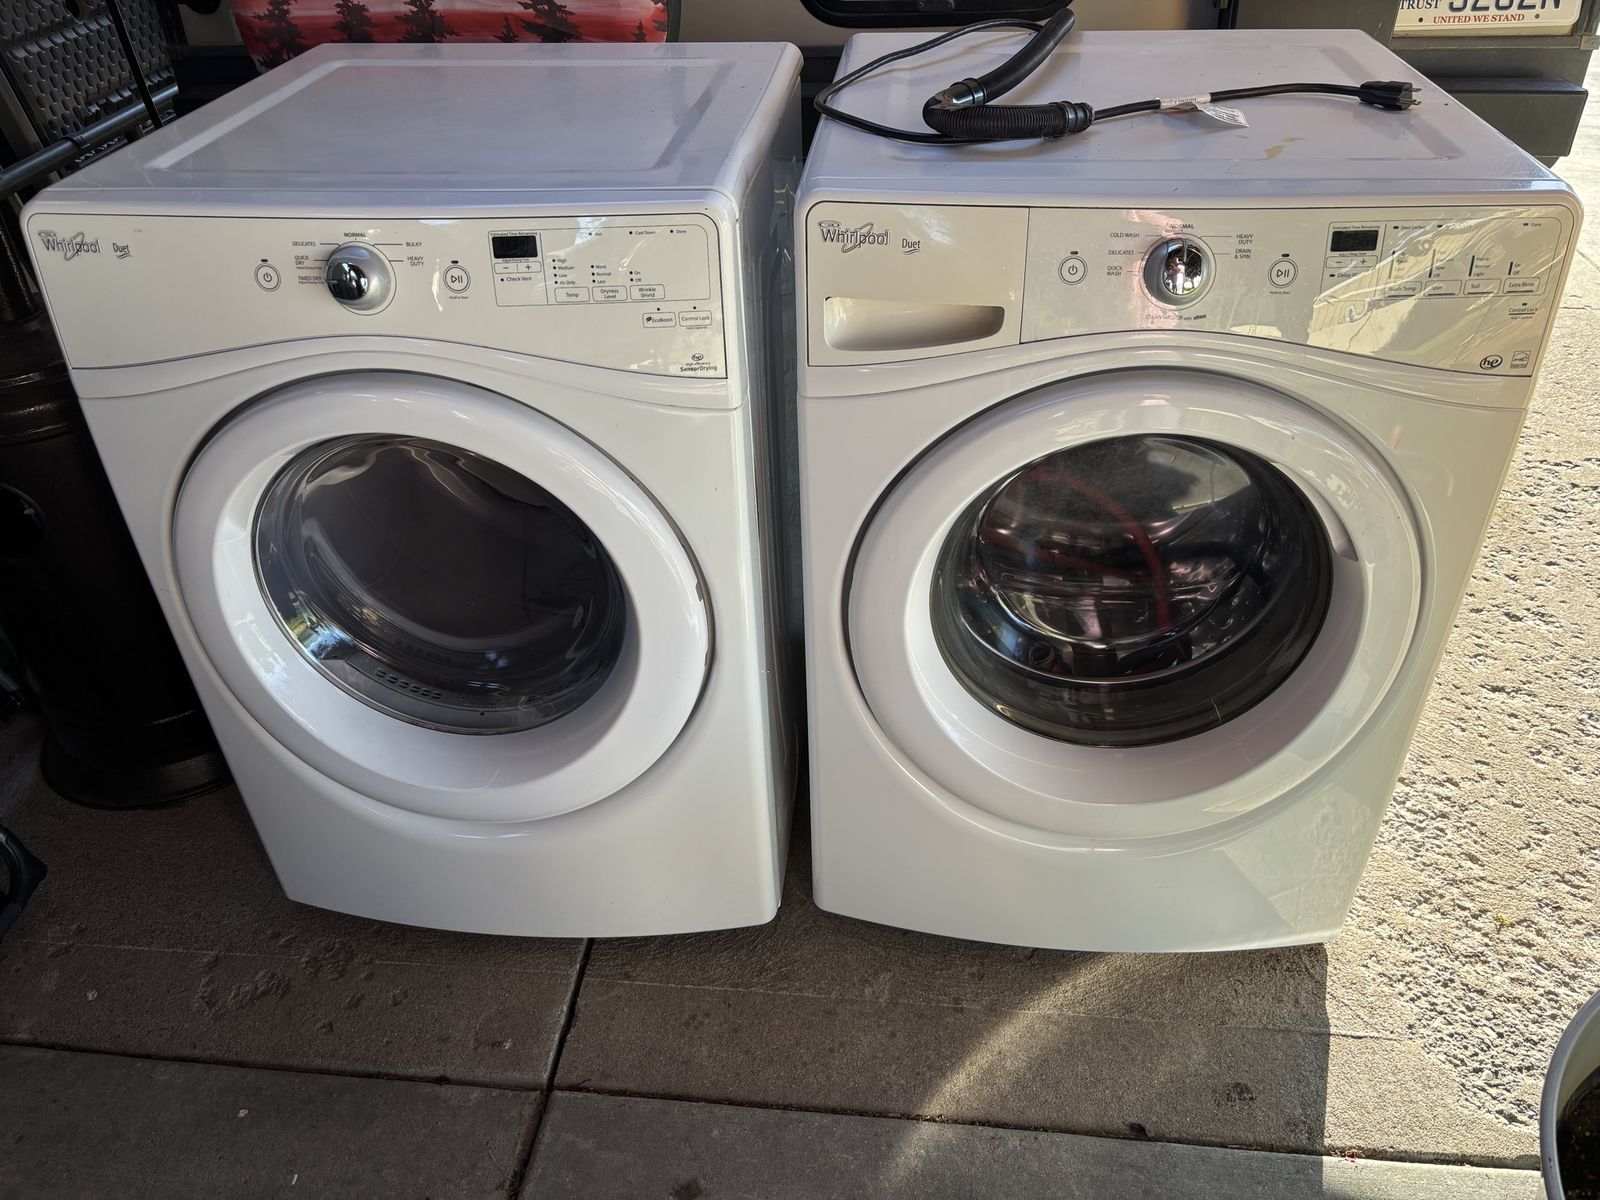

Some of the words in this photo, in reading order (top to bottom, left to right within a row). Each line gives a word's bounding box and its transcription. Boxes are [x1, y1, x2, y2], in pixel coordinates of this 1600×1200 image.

[1433, 15, 1470, 24] UNITED
[1473, 14, 1490, 23] WE
[1491, 14, 1524, 22] STAND
[820, 225, 890, 250] Whirlpool
[902, 238, 920, 250] Duet
[40, 235, 102, 258] Whirlpool
[112, 243, 130, 254] Duet
[1482, 356, 1500, 368] he
